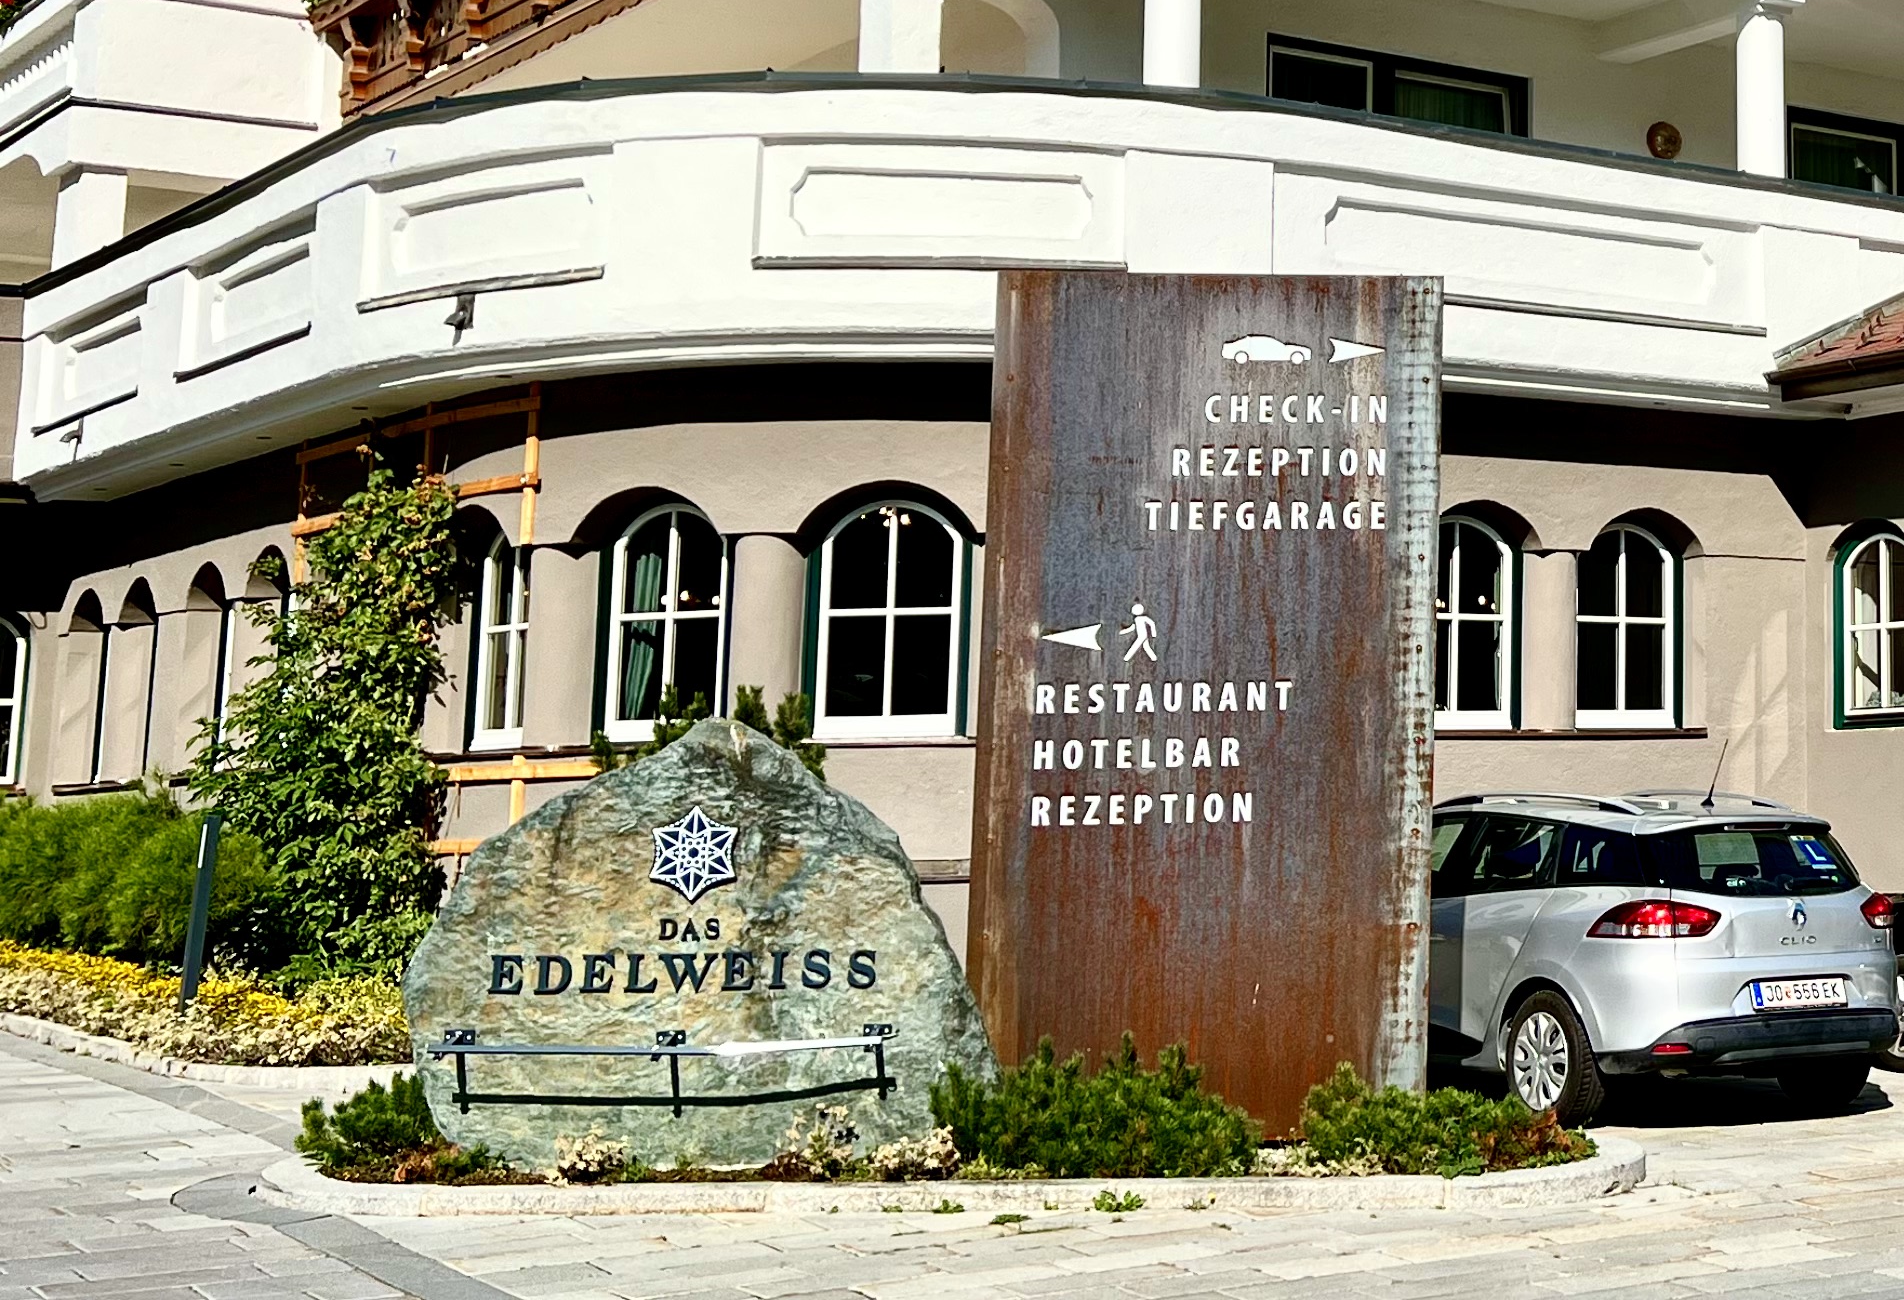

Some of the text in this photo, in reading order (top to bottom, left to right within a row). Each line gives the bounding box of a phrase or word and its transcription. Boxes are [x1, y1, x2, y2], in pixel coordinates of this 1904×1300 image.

[1204, 395, 1387, 424] CHECK-IN
[1172, 448, 1387, 477] REZEPTION
[1144, 501, 1387, 531] TIEFGARAGE
[1035, 681, 1293, 714] RESTAURANT
[1033, 737, 1240, 770] HOTELBAR
[1031, 792, 1253, 827] REZEPTION
[658, 917, 721, 942] DAS
[1780, 935, 1817, 946] CLIO
[487, 948, 878, 995] EDELWEISS
